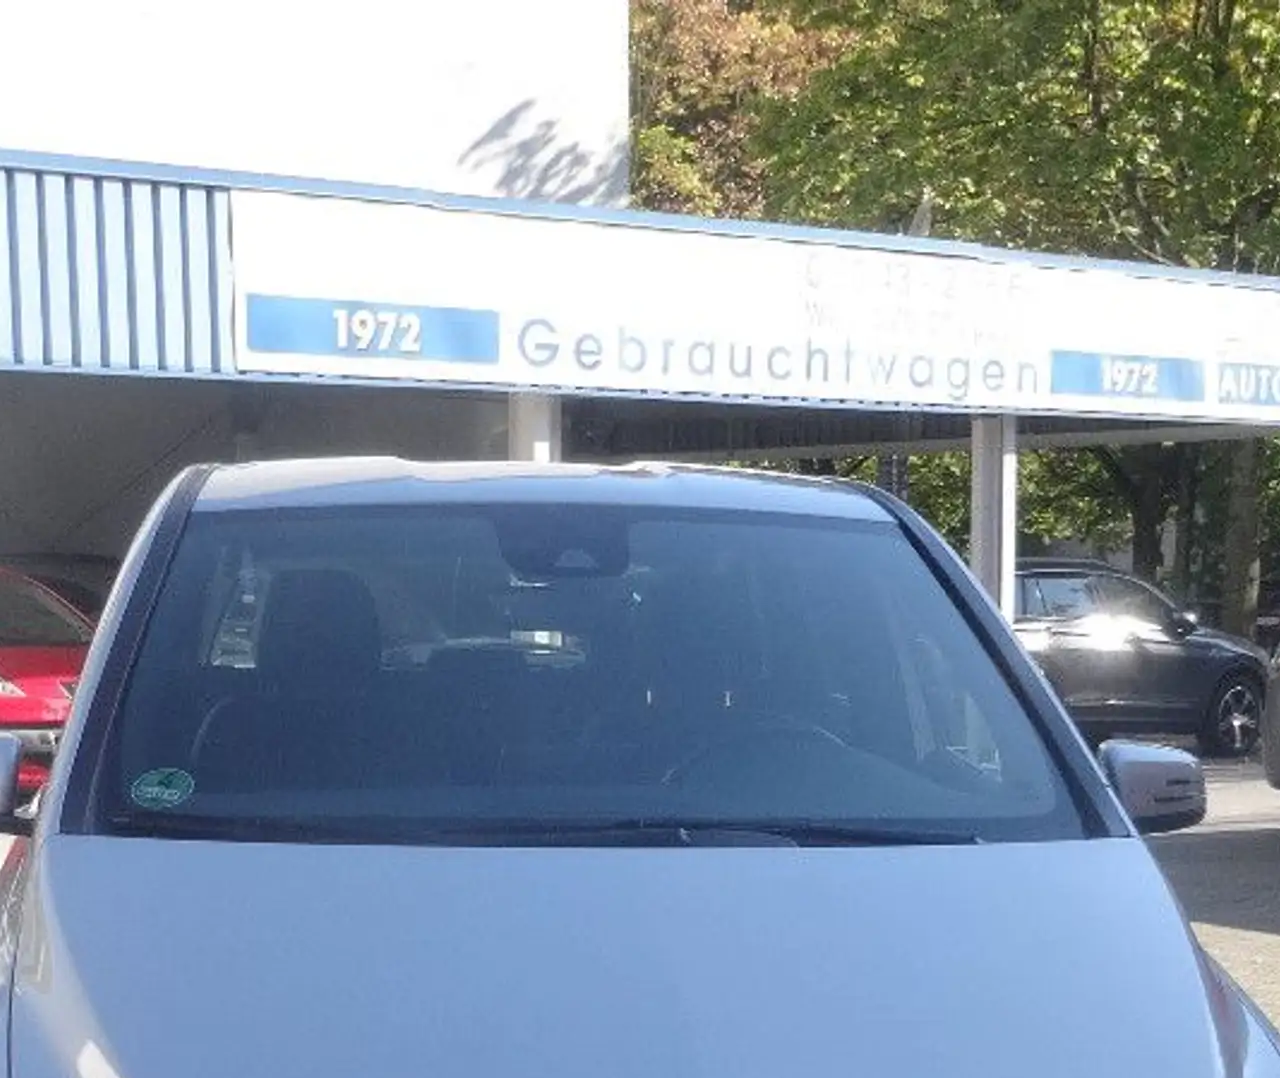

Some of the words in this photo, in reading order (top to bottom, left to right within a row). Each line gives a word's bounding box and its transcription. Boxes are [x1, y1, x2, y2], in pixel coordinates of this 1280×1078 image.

[332, 308, 422, 354] 1972
[517, 318, 1038, 401] Gebrauchtwagen
[1101, 358, 1160, 394] 1972
